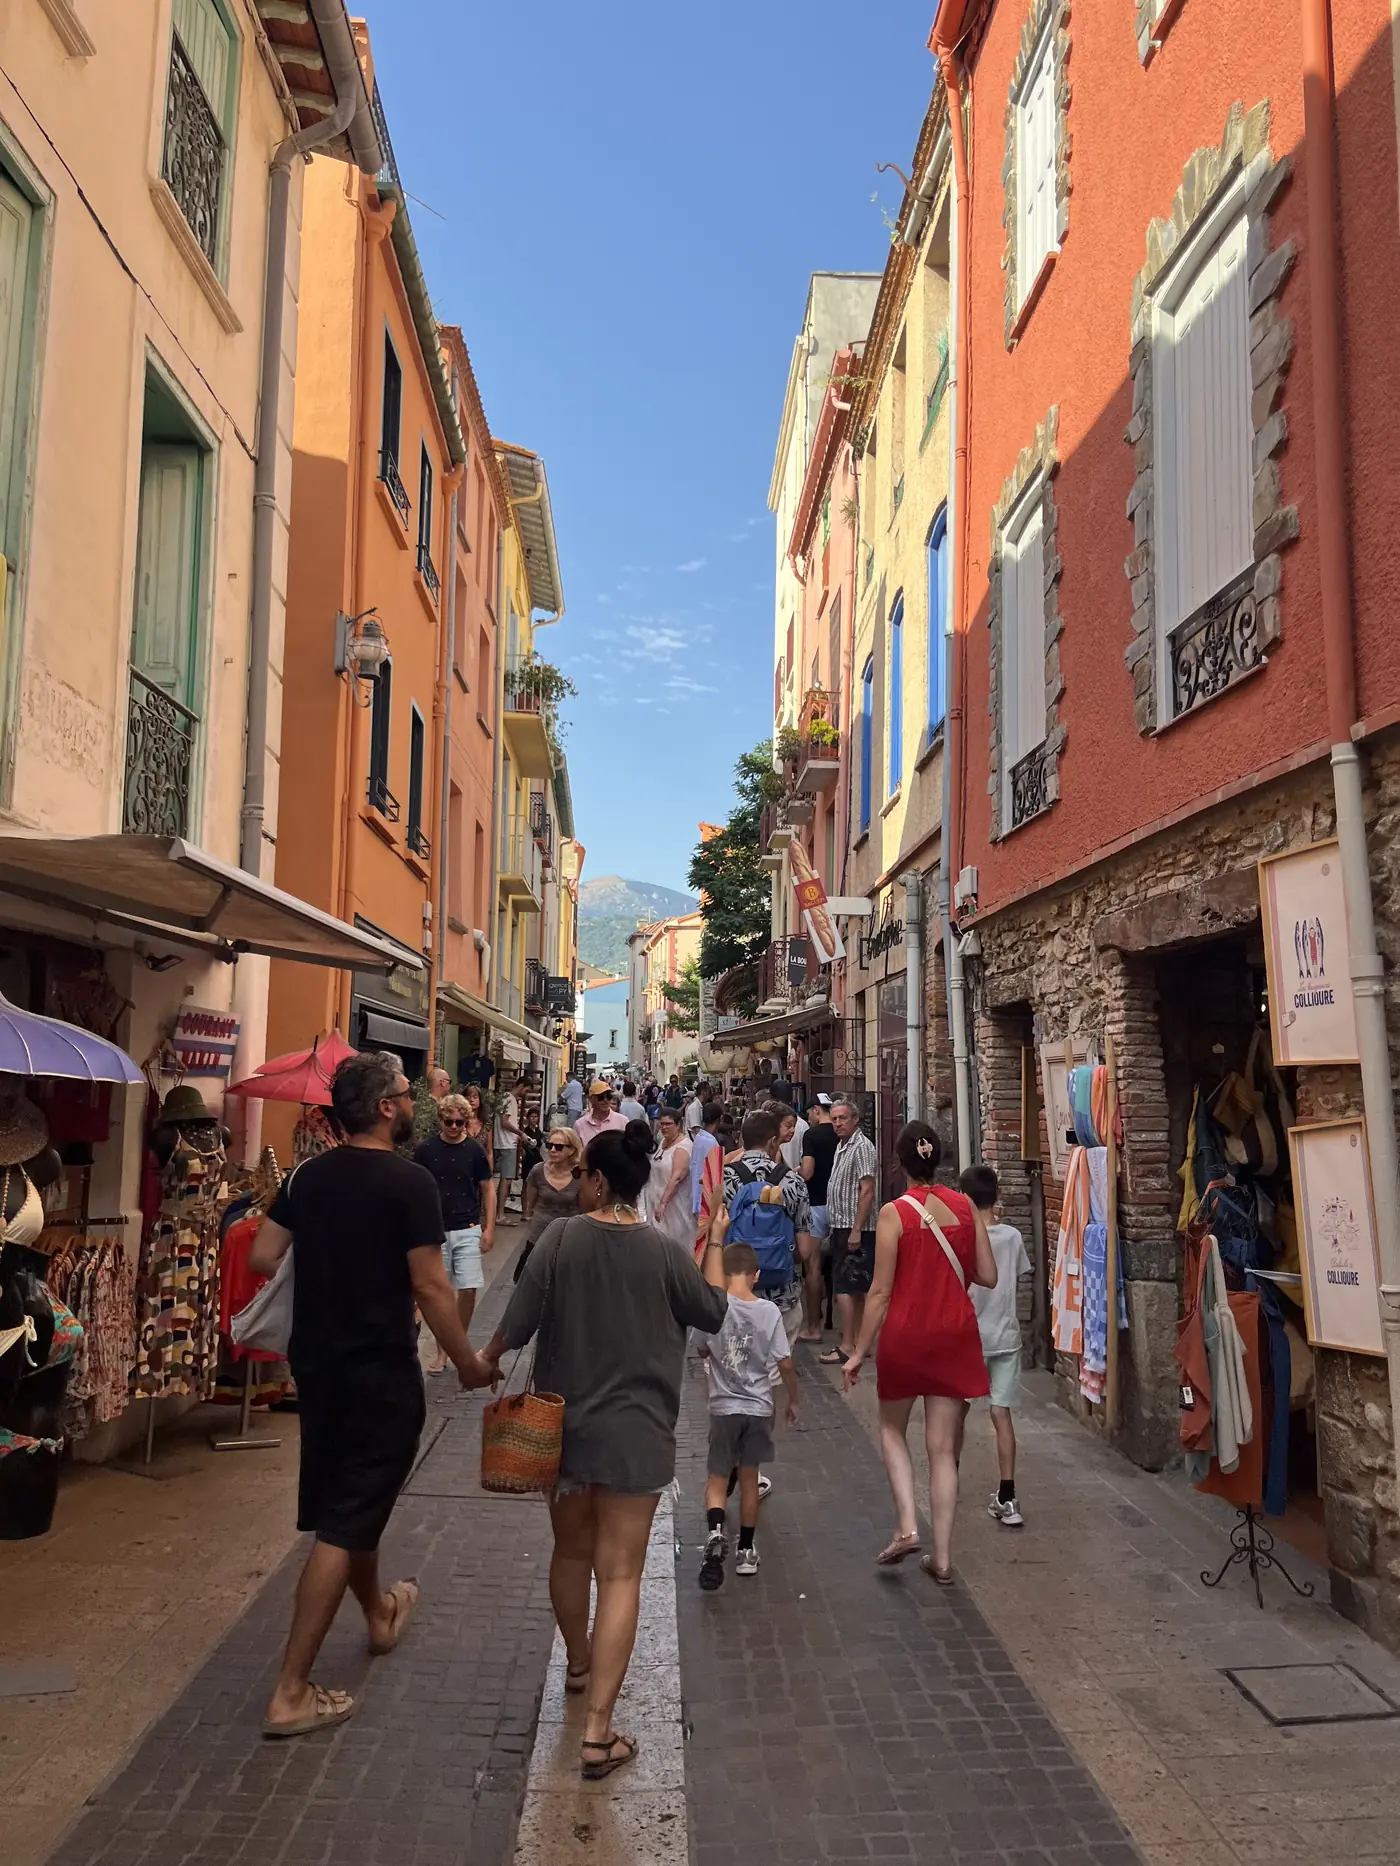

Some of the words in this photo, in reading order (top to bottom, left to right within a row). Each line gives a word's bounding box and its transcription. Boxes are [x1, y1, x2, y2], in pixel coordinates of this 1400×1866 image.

[790, 955, 797, 963] LA
[1293, 989, 1335, 1009] COLLIOURE
[1326, 1270, 1360, 1286] COLLIOURE
